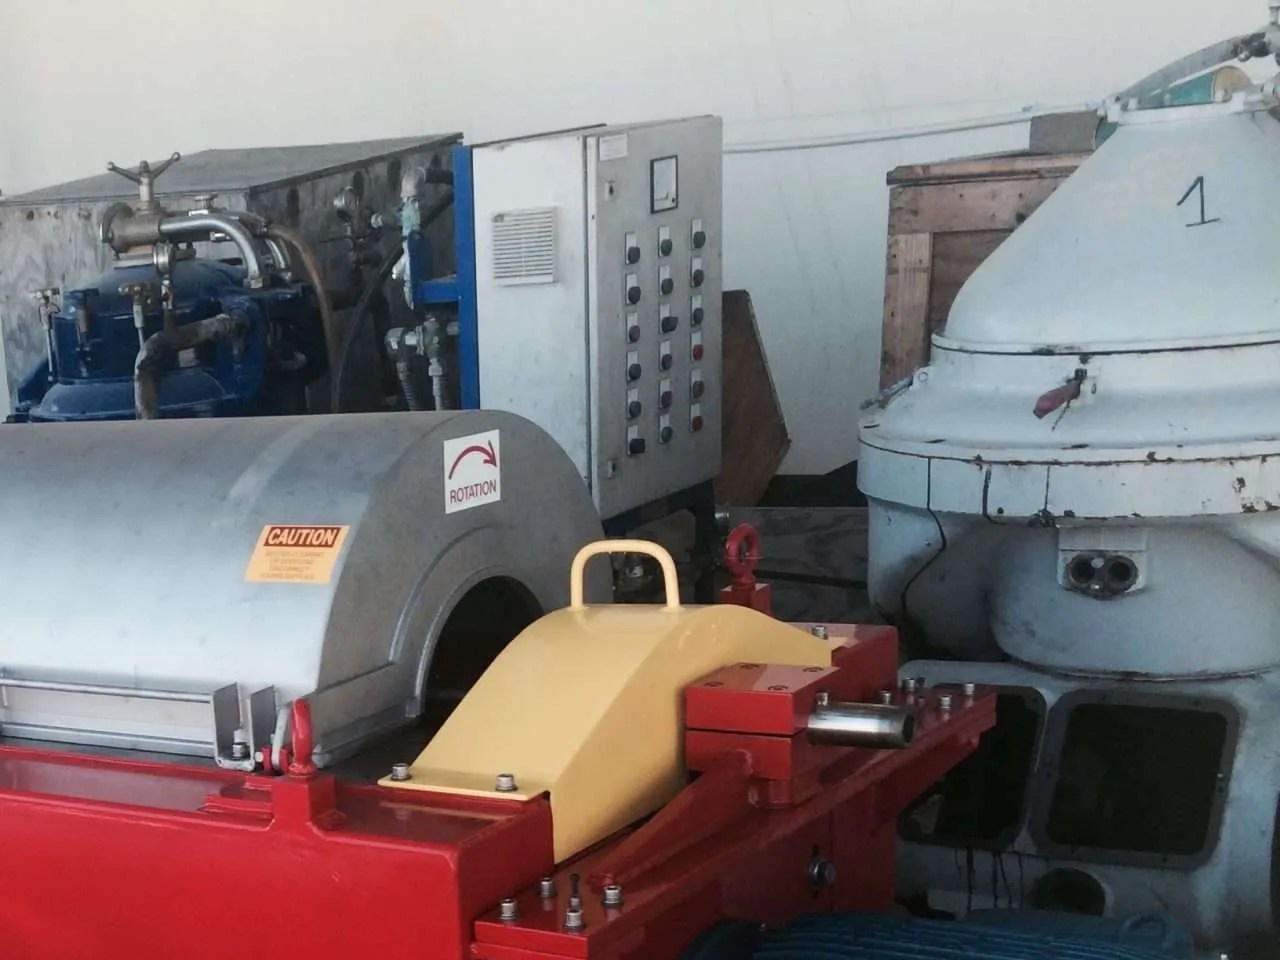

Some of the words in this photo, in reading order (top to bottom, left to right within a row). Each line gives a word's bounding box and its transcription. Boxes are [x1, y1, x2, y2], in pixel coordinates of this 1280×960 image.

[1176, 176, 1221, 227] 1
[449, 480, 497, 504] ROTATION
[267, 528, 338, 545] CAUTION
